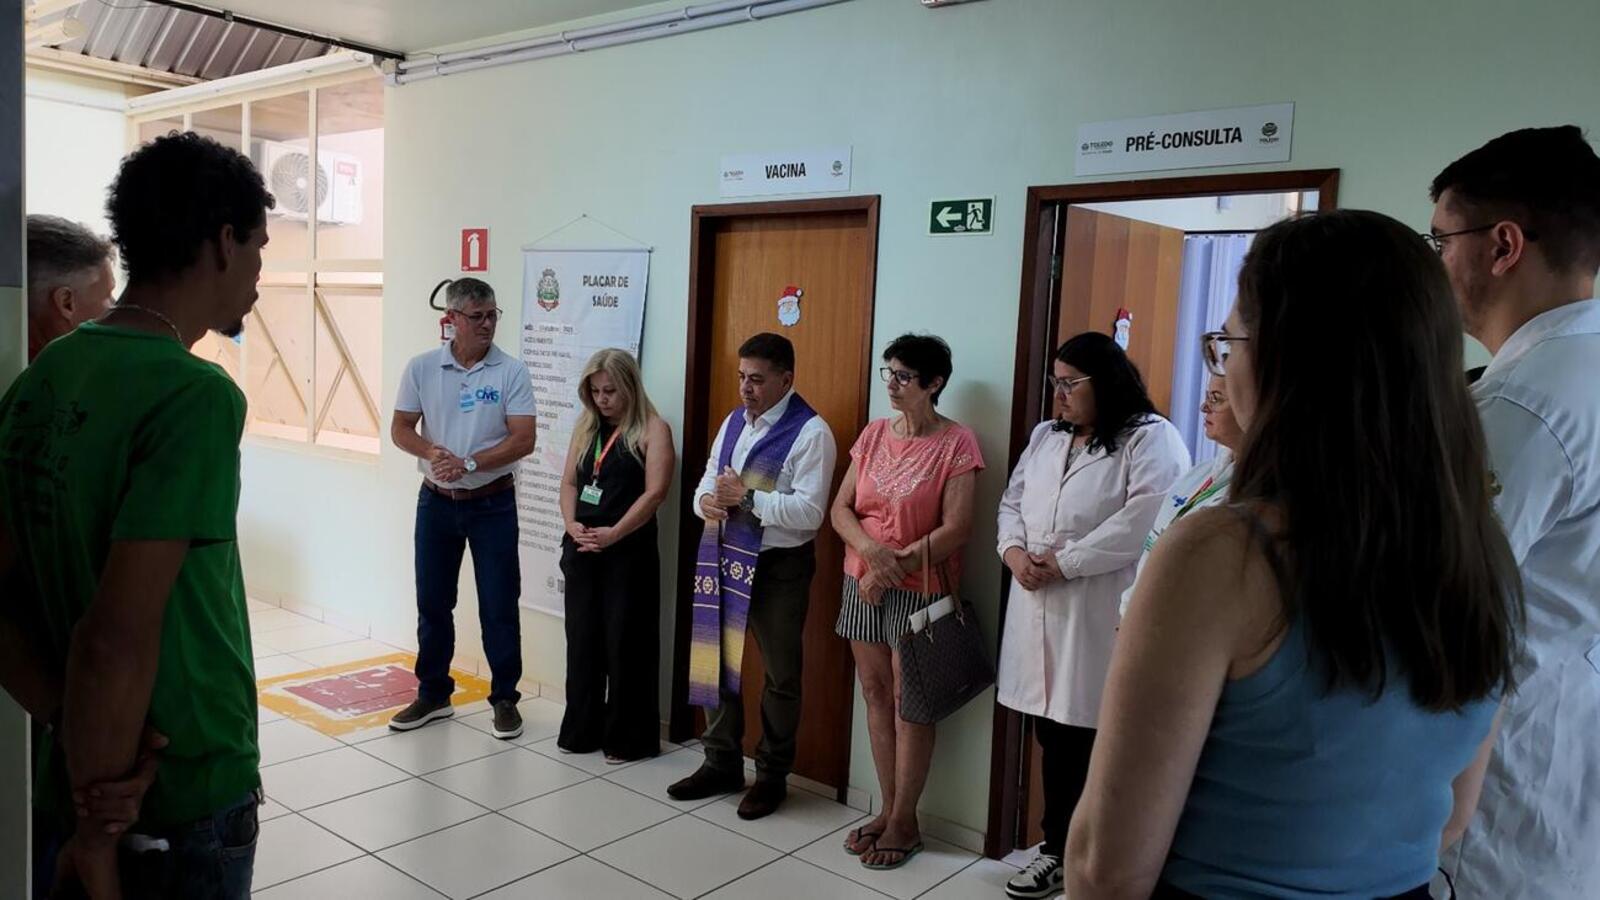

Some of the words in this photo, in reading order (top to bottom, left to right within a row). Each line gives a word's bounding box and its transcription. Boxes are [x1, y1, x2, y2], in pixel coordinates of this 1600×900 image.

[1125, 127, 1242, 152] PRÉ-CONSULTA
[765, 162, 806, 179] VACINA
[582, 275, 617, 287] PLACAR
[618, 276, 629, 288] DE
[592, 293, 619, 307] SAÚDE
[475, 387, 500, 403] CMS
